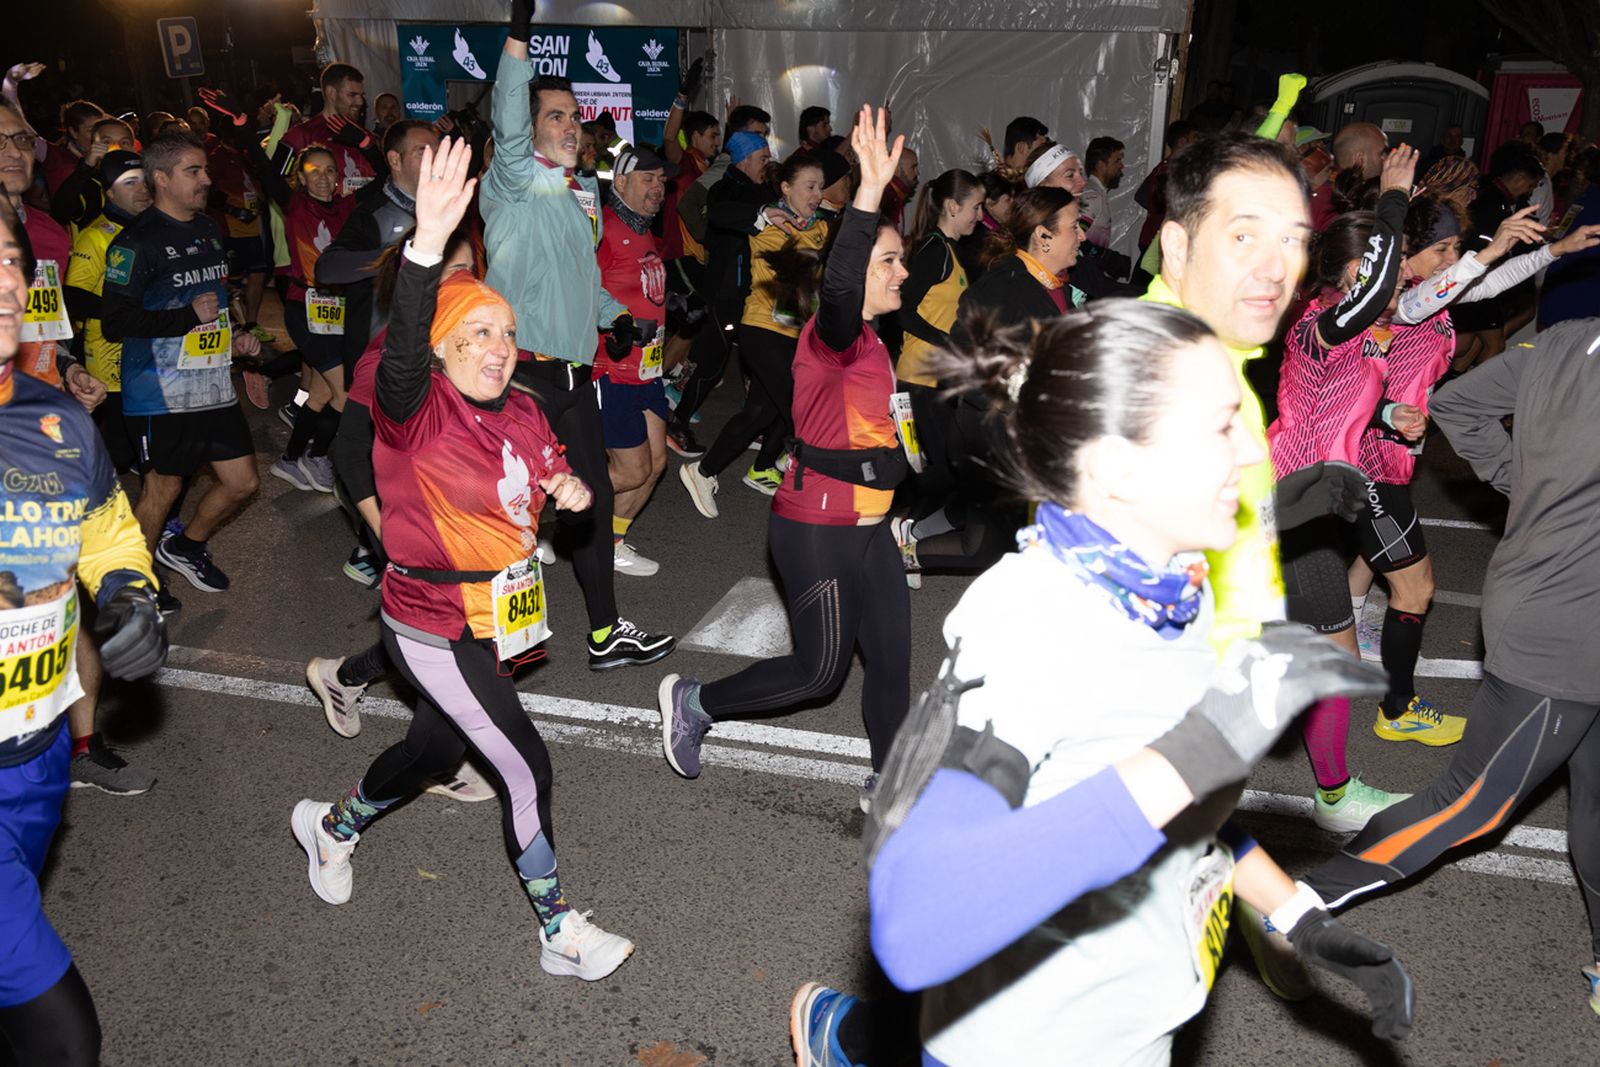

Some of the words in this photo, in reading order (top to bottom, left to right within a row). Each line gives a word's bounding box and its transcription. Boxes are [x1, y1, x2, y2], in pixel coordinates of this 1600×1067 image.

[168, 25, 192, 70] P
[529, 35, 570, 55] SAN
[463, 56, 475, 71] 43
[595, 59, 610, 74] 43
[173, 270, 201, 288] SAN
[316, 305, 342, 320] 1560
[198, 331, 222, 350] 527
[508, 584, 541, 623] 8432
[1, 621, 39, 640] OCHE
[41, 614, 58, 631] DE
[6, 630, 56, 656] ANTÓN
